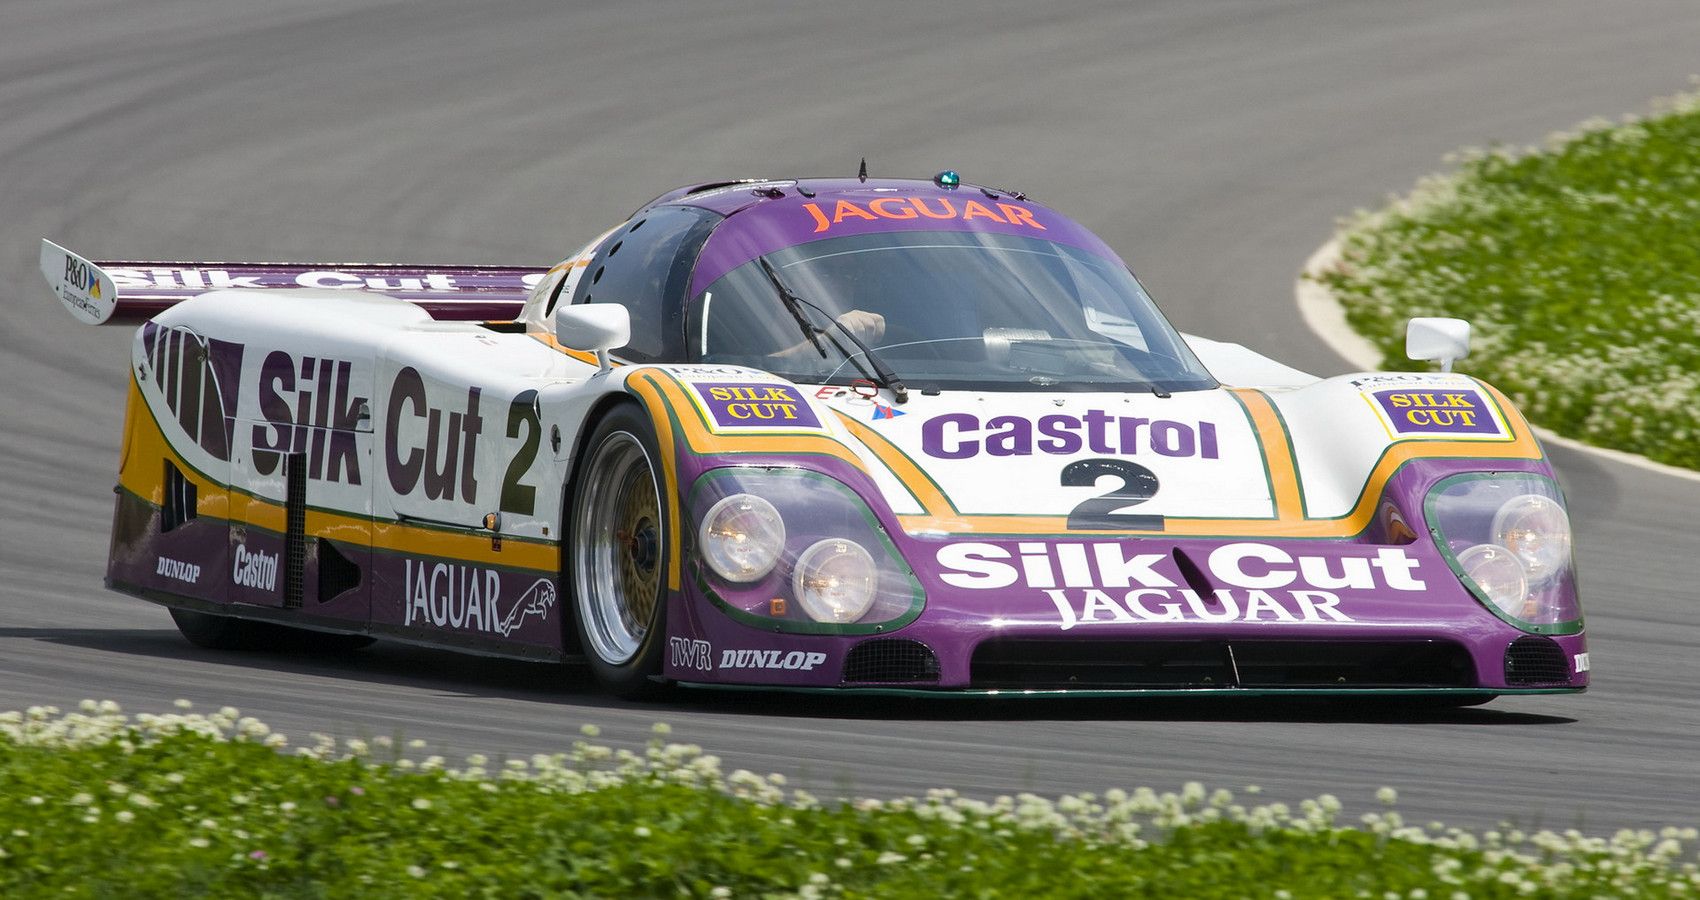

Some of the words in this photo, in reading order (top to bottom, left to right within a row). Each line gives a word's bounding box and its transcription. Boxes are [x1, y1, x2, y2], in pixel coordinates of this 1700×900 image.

[803, 197, 1047, 233] JAGUAR
[64, 254, 87, 290] P&O
[295, 271, 460, 291] Cut
[709, 386, 797, 402] SILK
[727, 403, 798, 420] CUT
[1389, 393, 1476, 408] SILK
[251, 350, 369, 486] Silk
[385, 366, 483, 505] Cut
[922, 409, 1219, 459] Castrol
[1406, 409, 1477, 426] CUT
[500, 389, 542, 517] 2
[1060, 458, 1165, 531] 2
[156, 556, 200, 584] DUNLOP
[233, 543, 279, 592] Castrol
[936, 542, 1179, 589] Silk
[1208, 543, 1427, 591] Cut
[404, 559, 502, 633] JAGUAR
[1042, 588, 1356, 631] JAGUAR
[670, 636, 713, 671] TWR
[719, 649, 827, 671] DUNLOP
